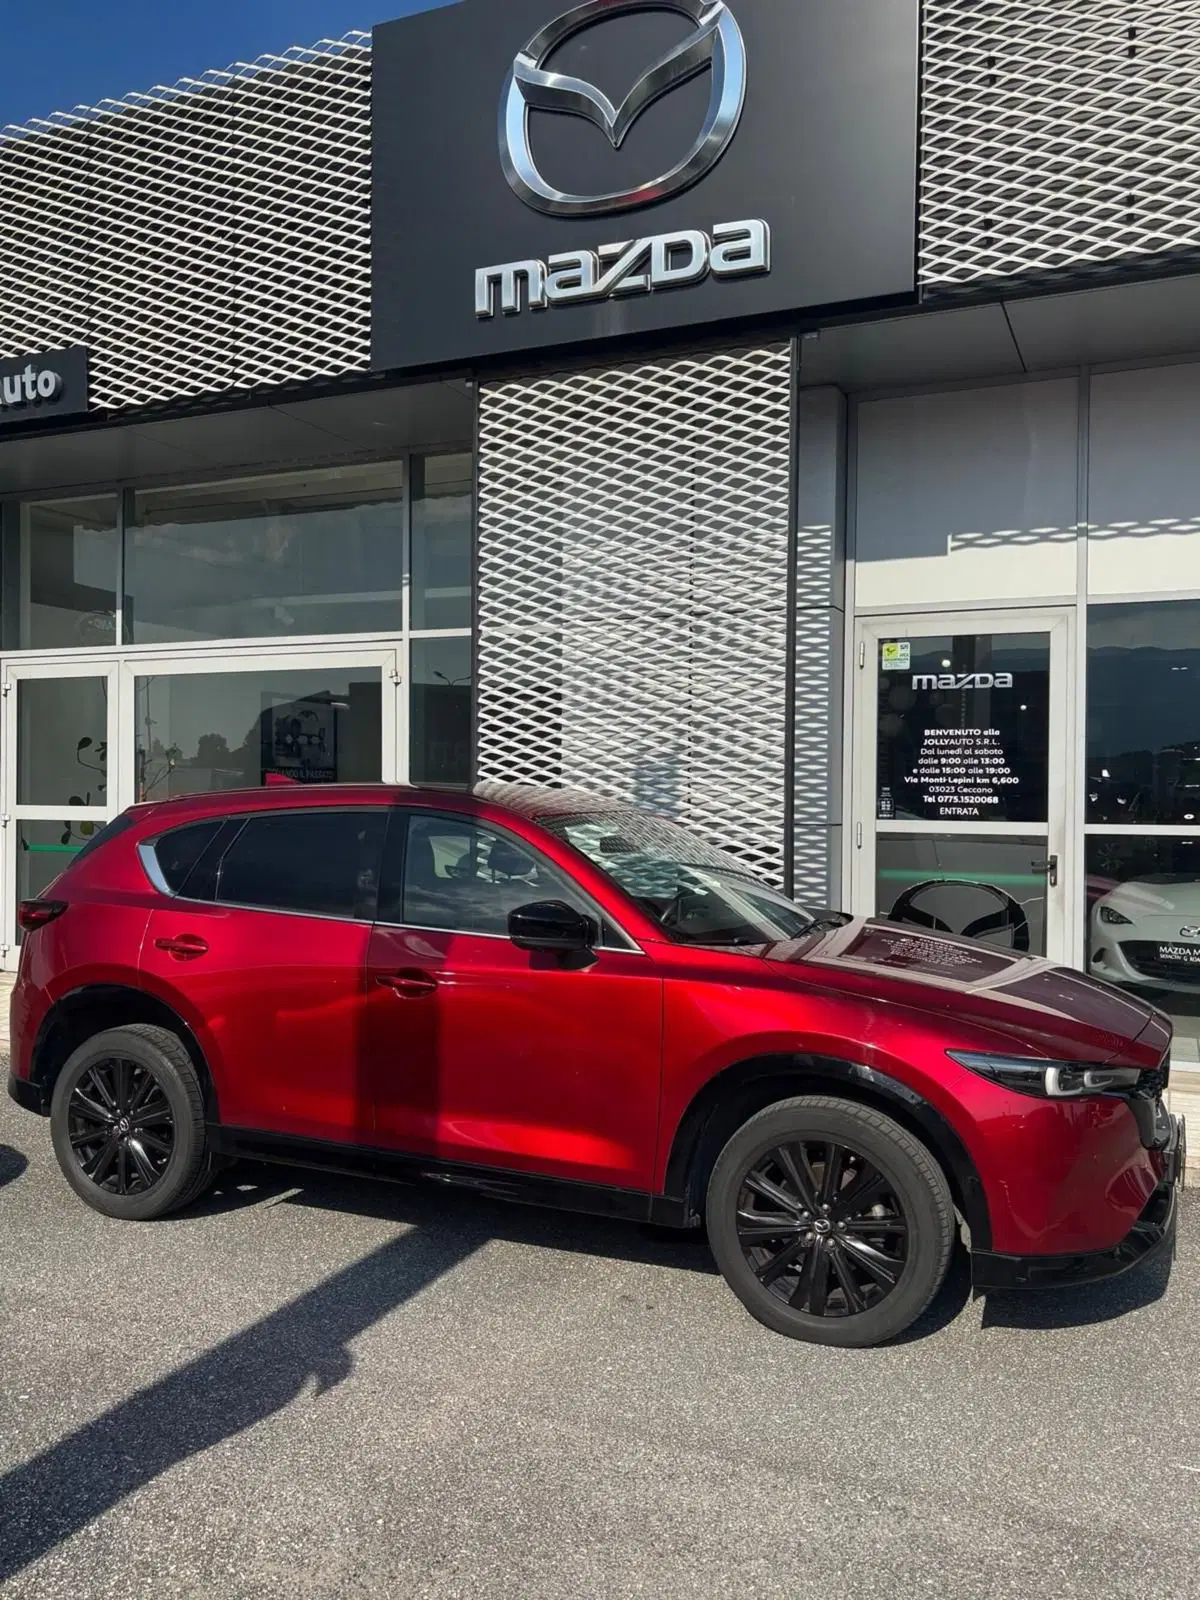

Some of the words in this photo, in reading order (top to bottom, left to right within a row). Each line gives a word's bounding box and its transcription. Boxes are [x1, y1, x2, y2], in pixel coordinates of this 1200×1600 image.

[0, 364, 56, 404] uto
[923, 738, 974, 746] JOLLYAUTO
[976, 738, 1000, 746] S.R.L.
[948, 777, 974, 785] Lepini
[991, 777, 1020, 785] 6,600
[957, 786, 993, 794] Ceccano
[937, 796, 999, 804] 0775.1520068
[939, 807, 980, 816] ENTRATA
[1159, 946, 1191, 955] MAZDA
